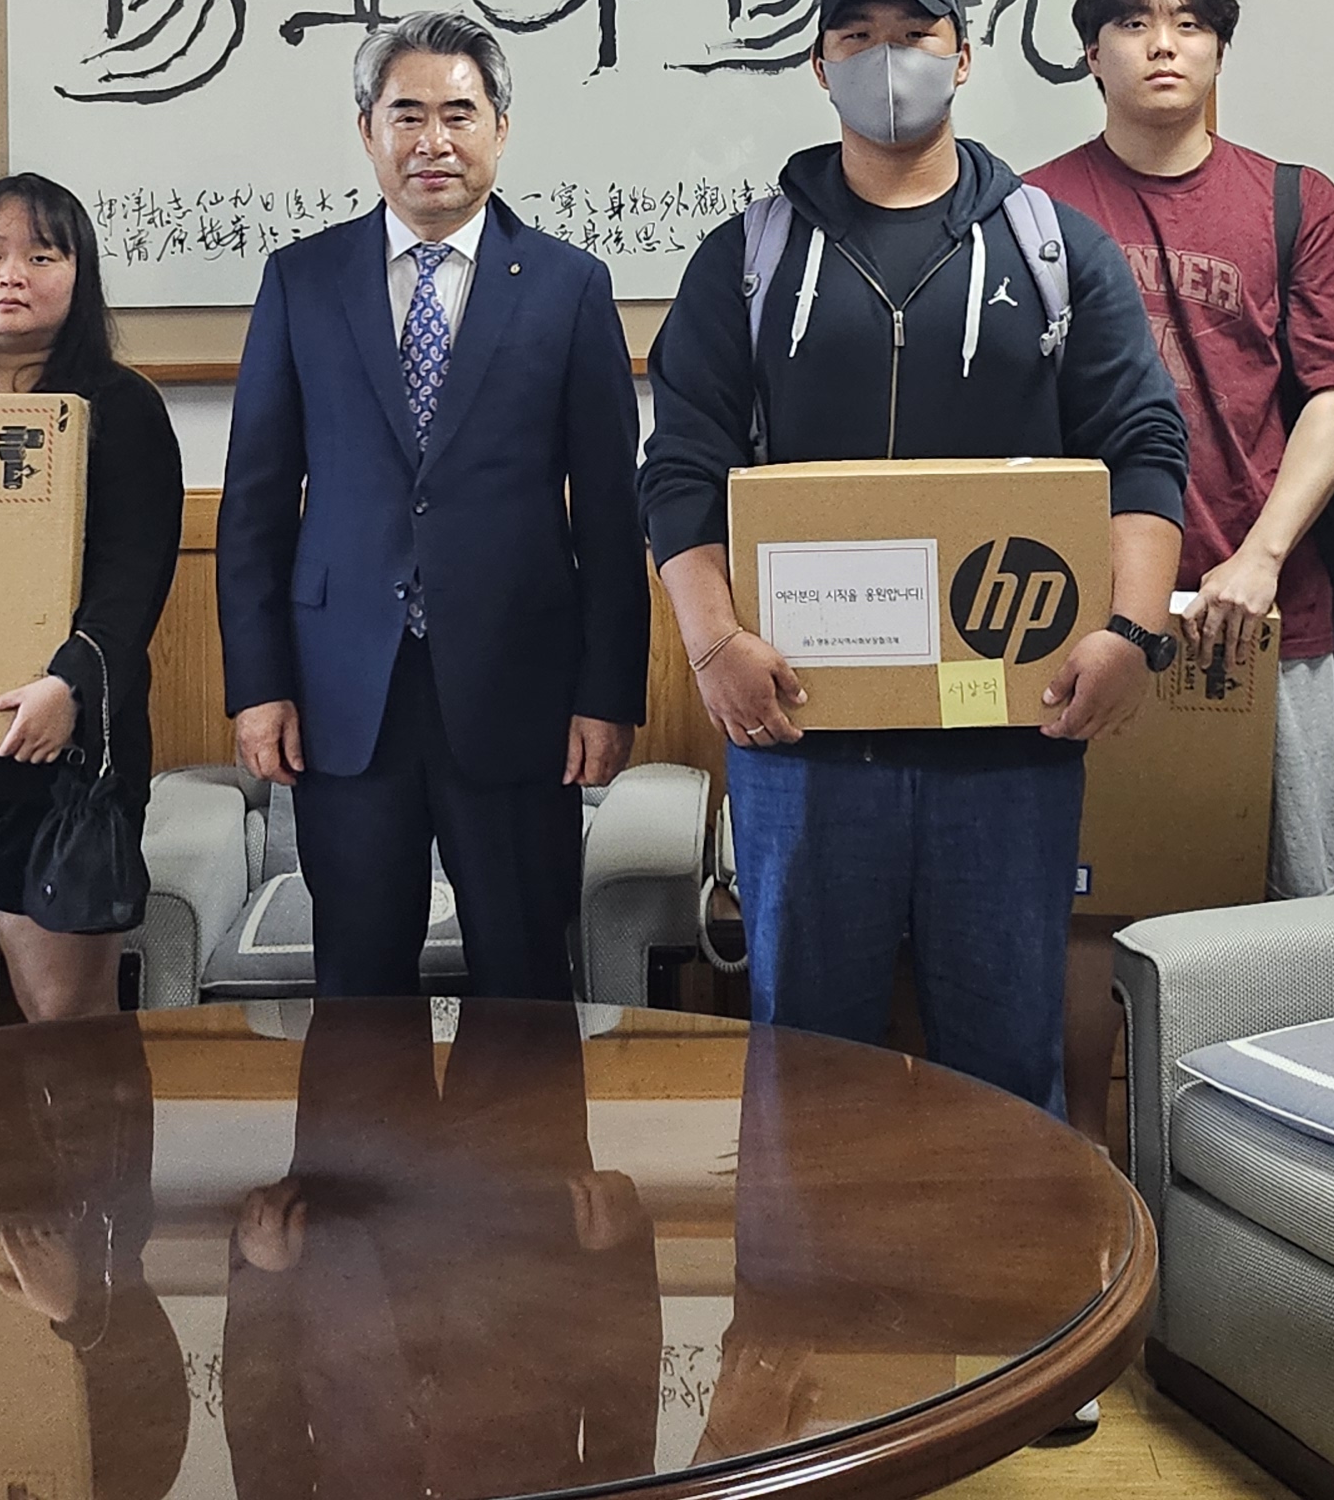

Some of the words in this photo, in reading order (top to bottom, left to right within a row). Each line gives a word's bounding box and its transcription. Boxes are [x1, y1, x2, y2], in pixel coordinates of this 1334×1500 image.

[775, 588, 820, 603] 여러분의
[825, 588, 858, 603] 시작을
[965, 537, 1067, 664] hp
